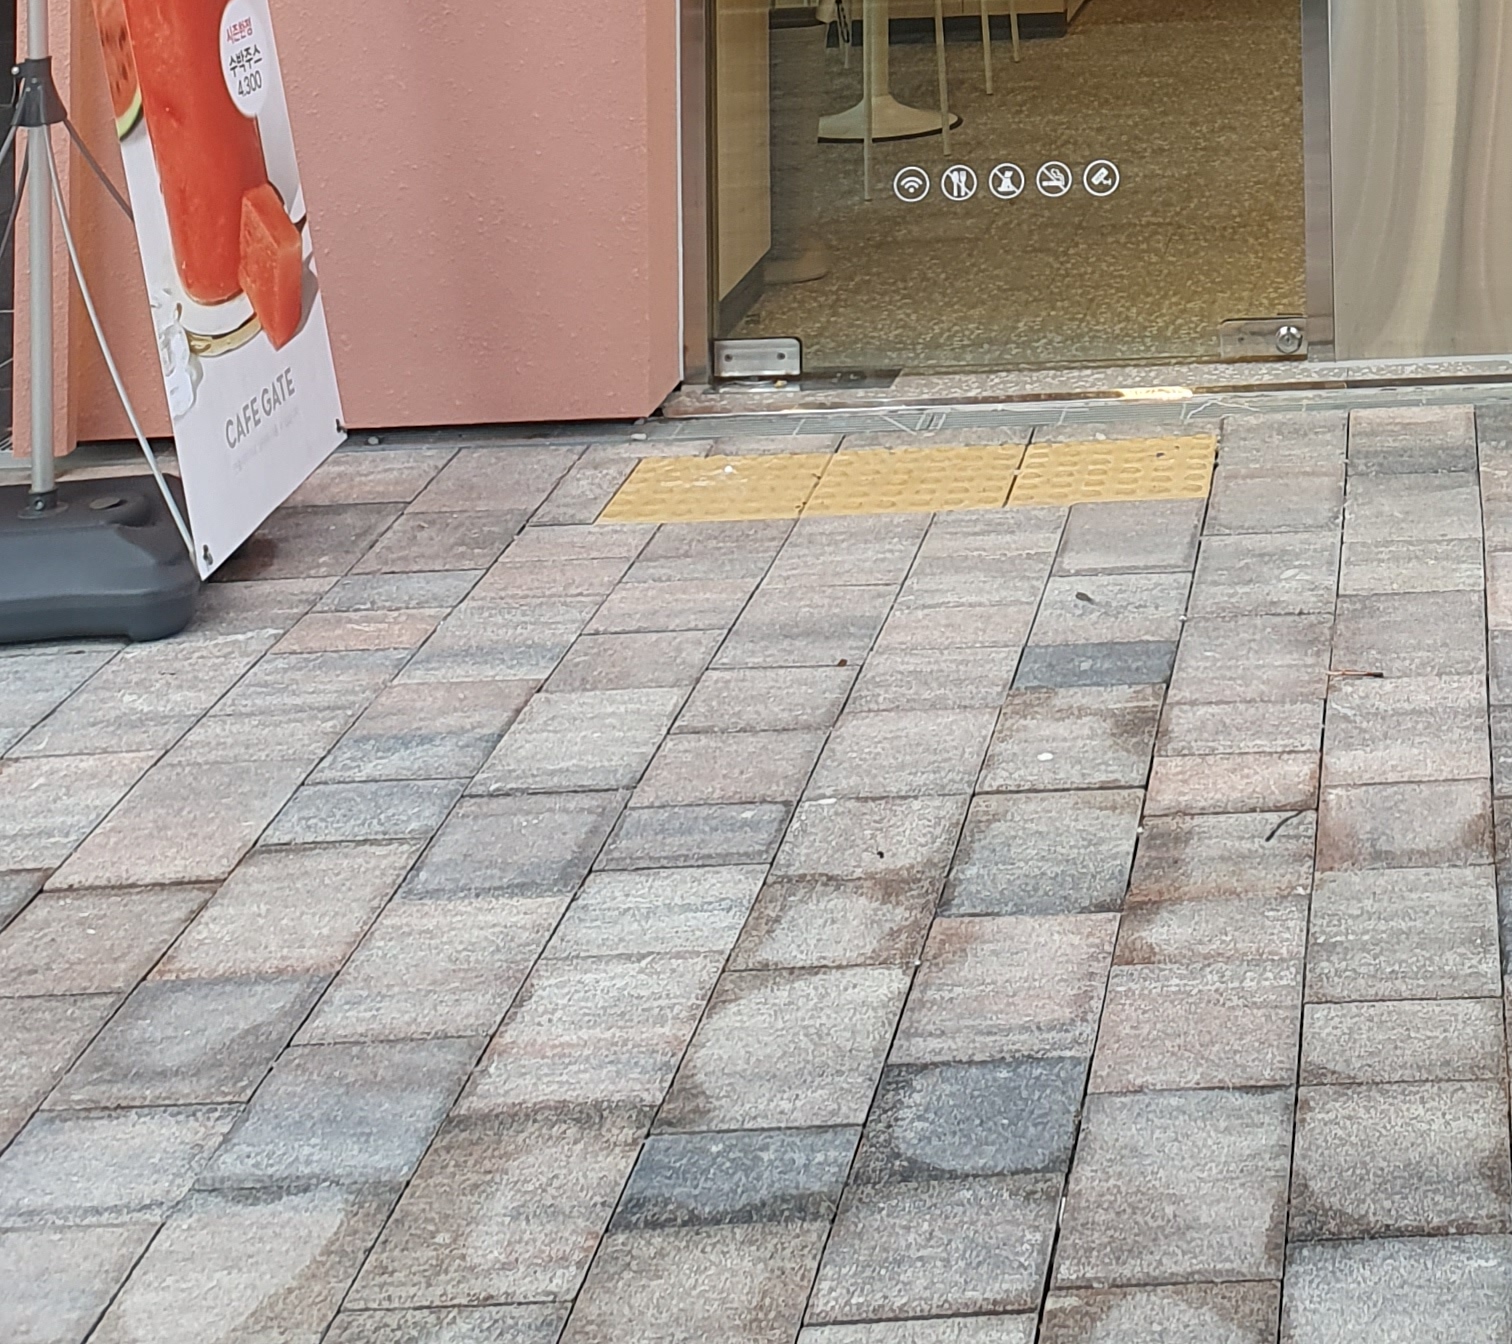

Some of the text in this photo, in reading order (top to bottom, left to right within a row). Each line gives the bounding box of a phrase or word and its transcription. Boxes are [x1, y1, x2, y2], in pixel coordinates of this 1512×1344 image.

[229, 44, 263, 78] 수박주스
[225, 366, 296, 449] CAFE GATE
